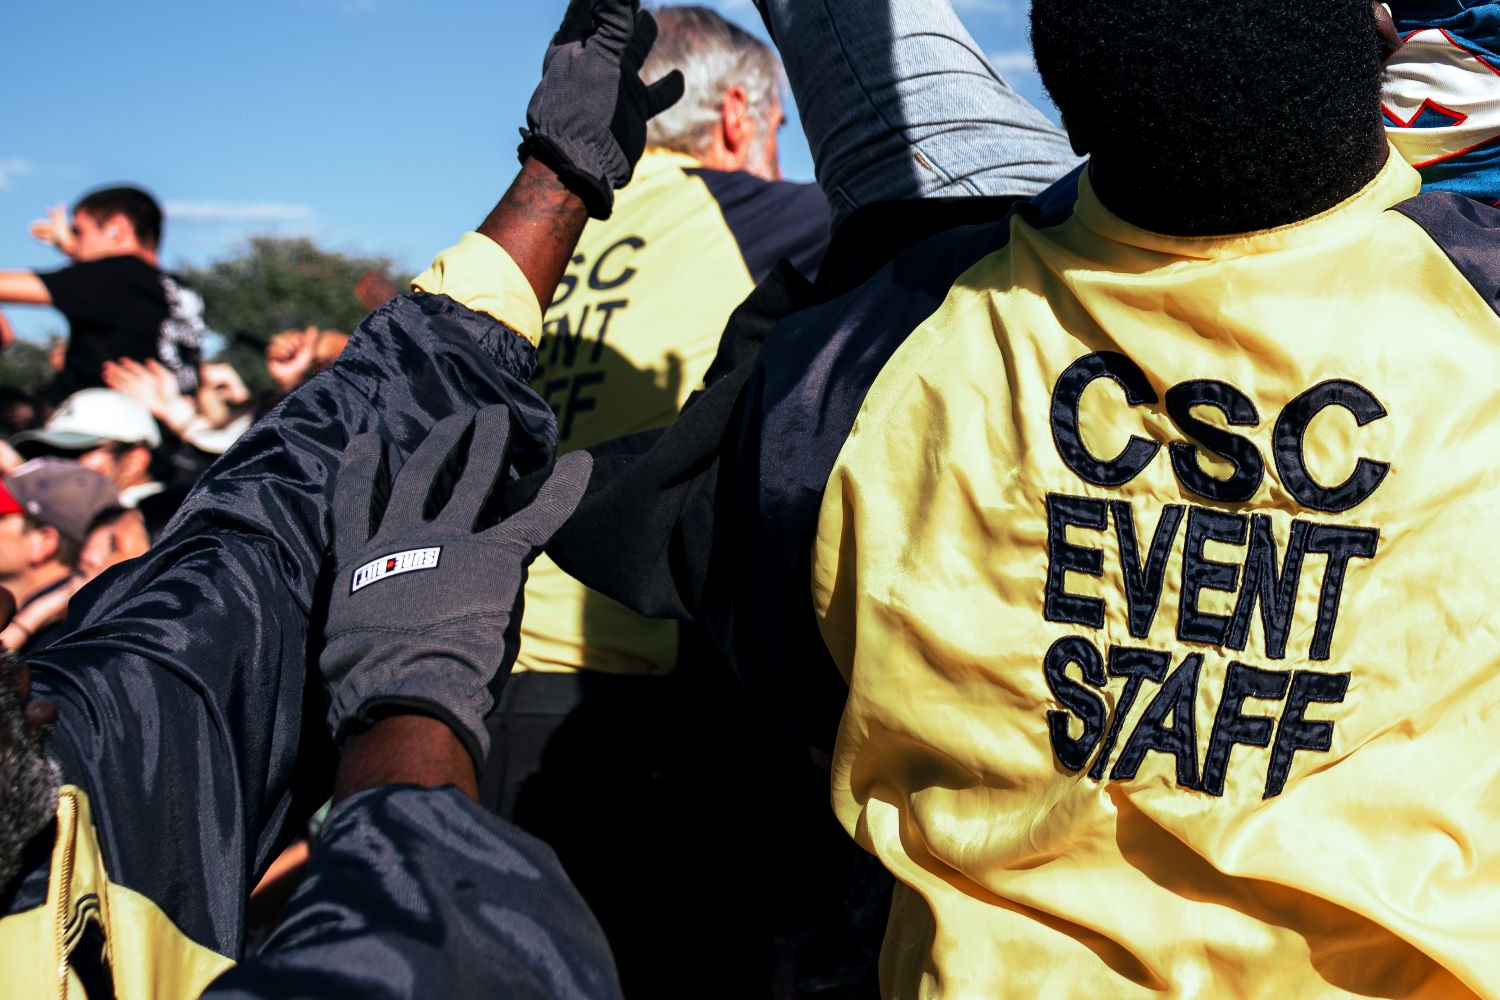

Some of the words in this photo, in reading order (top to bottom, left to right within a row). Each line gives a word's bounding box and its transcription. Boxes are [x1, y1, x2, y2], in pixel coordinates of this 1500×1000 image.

[1049, 350, 1391, 513] CSC
[1043, 492, 1381, 661] EVENT
[1043, 635, 1352, 800] STAFF
